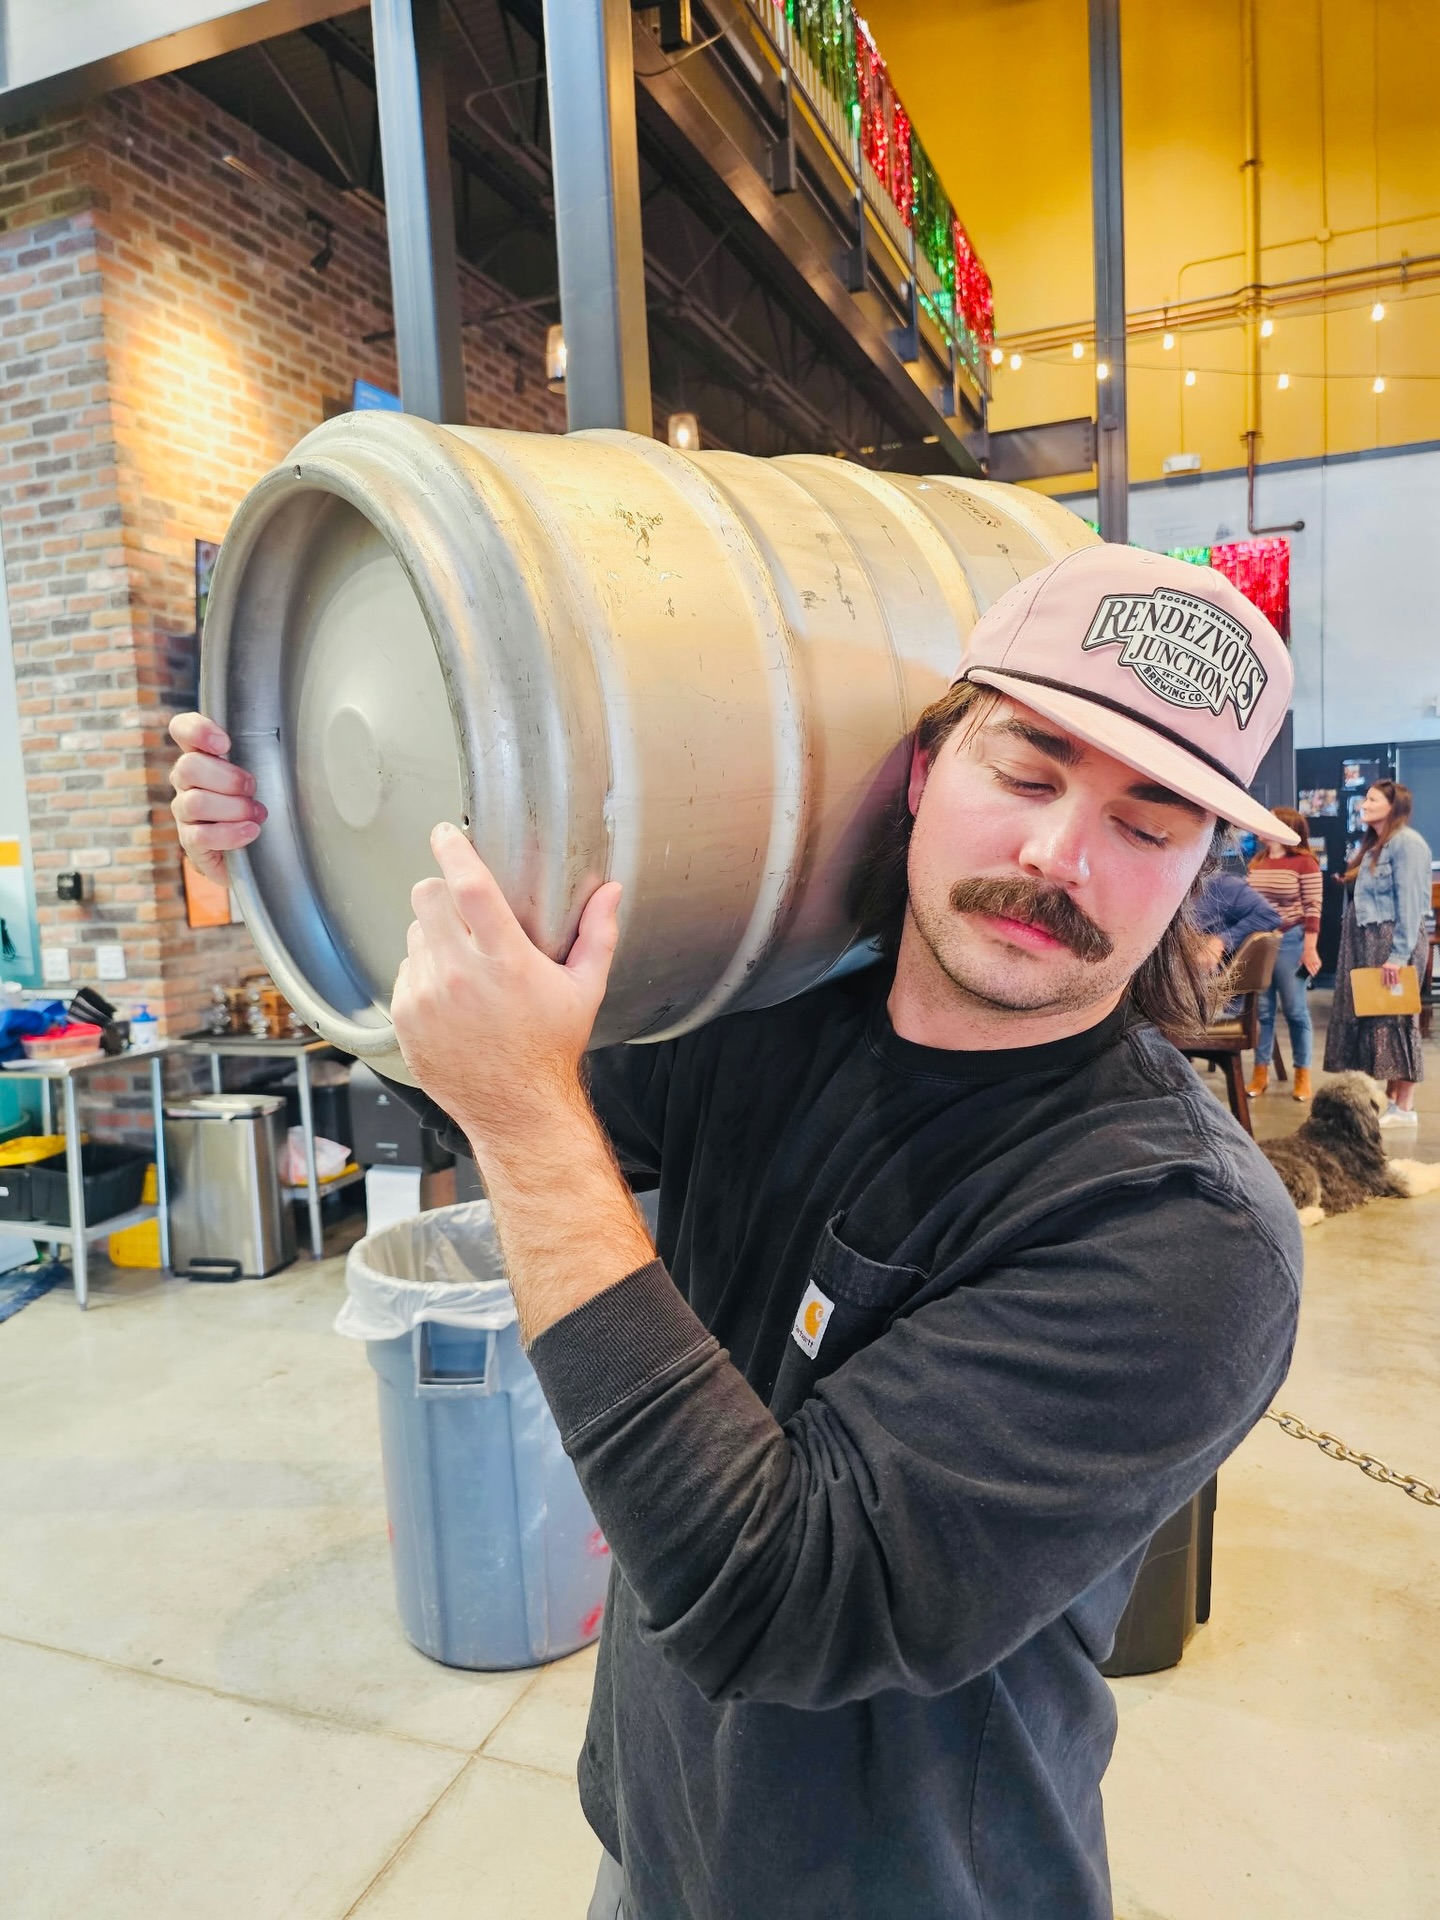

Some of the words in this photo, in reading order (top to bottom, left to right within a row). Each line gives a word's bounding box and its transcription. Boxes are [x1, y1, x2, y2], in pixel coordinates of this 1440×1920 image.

[1204, 608, 1245, 641] ARKANSAS
[1094, 600, 1260, 710] RENDEZVOUS
[1129, 634, 1228, 704] JUNCTION
[1143, 666, 1186, 701] BREWING
[1188, 691, 1205, 702] CO.
